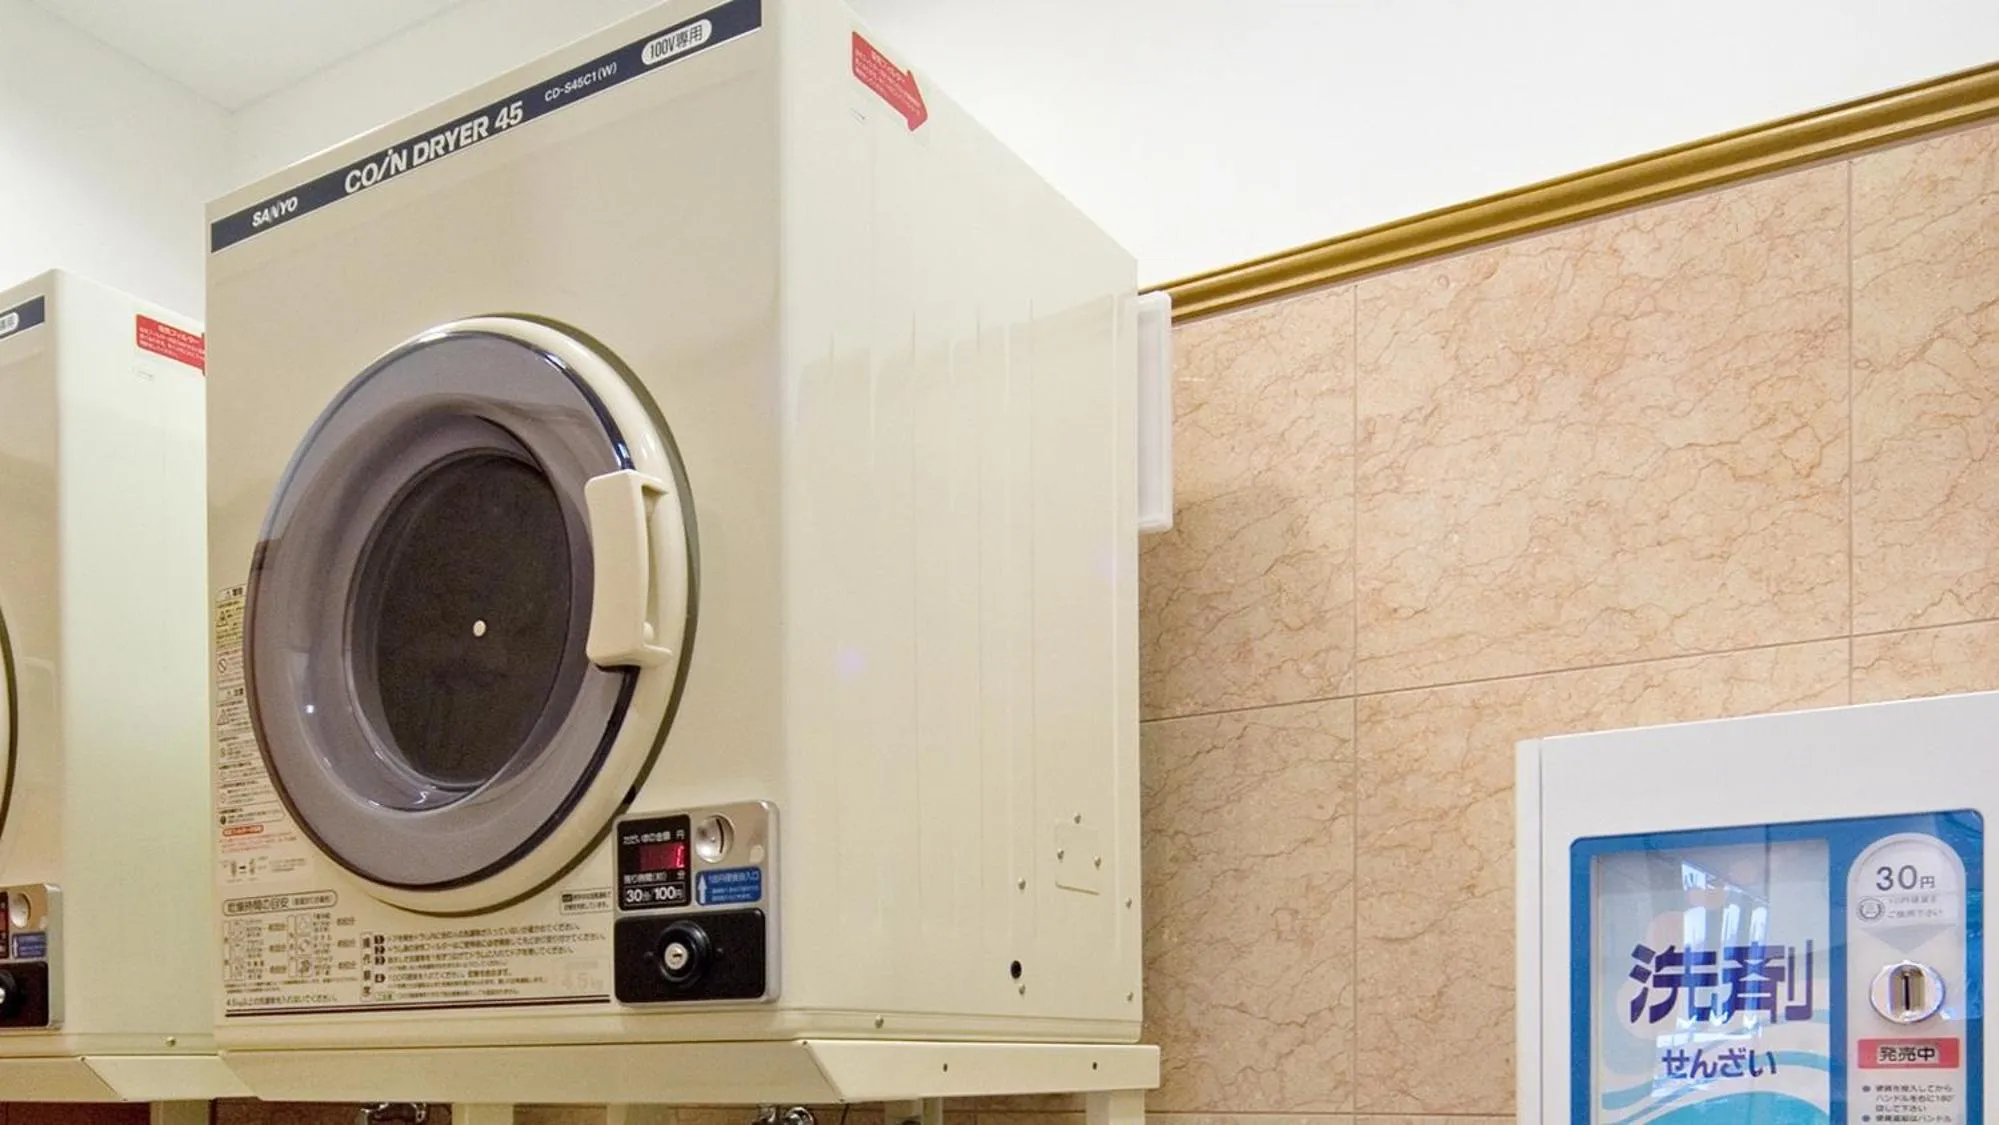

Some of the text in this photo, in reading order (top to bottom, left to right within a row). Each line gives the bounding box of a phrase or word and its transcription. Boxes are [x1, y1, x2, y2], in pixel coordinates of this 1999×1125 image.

[544, 61, 618, 102] CD-S45C1(W)
[413, 114, 489, 166] DRYER
[494, 100, 524, 130] 45
[251, 196, 299, 228] SANYO
[1876, 865, 1935, 892] 30円
[1628, 939, 1813, 1025] 洗剤
[1661, 1047, 1777, 1079] せんざい
[1877, 1045, 1937, 1063] 発売中
